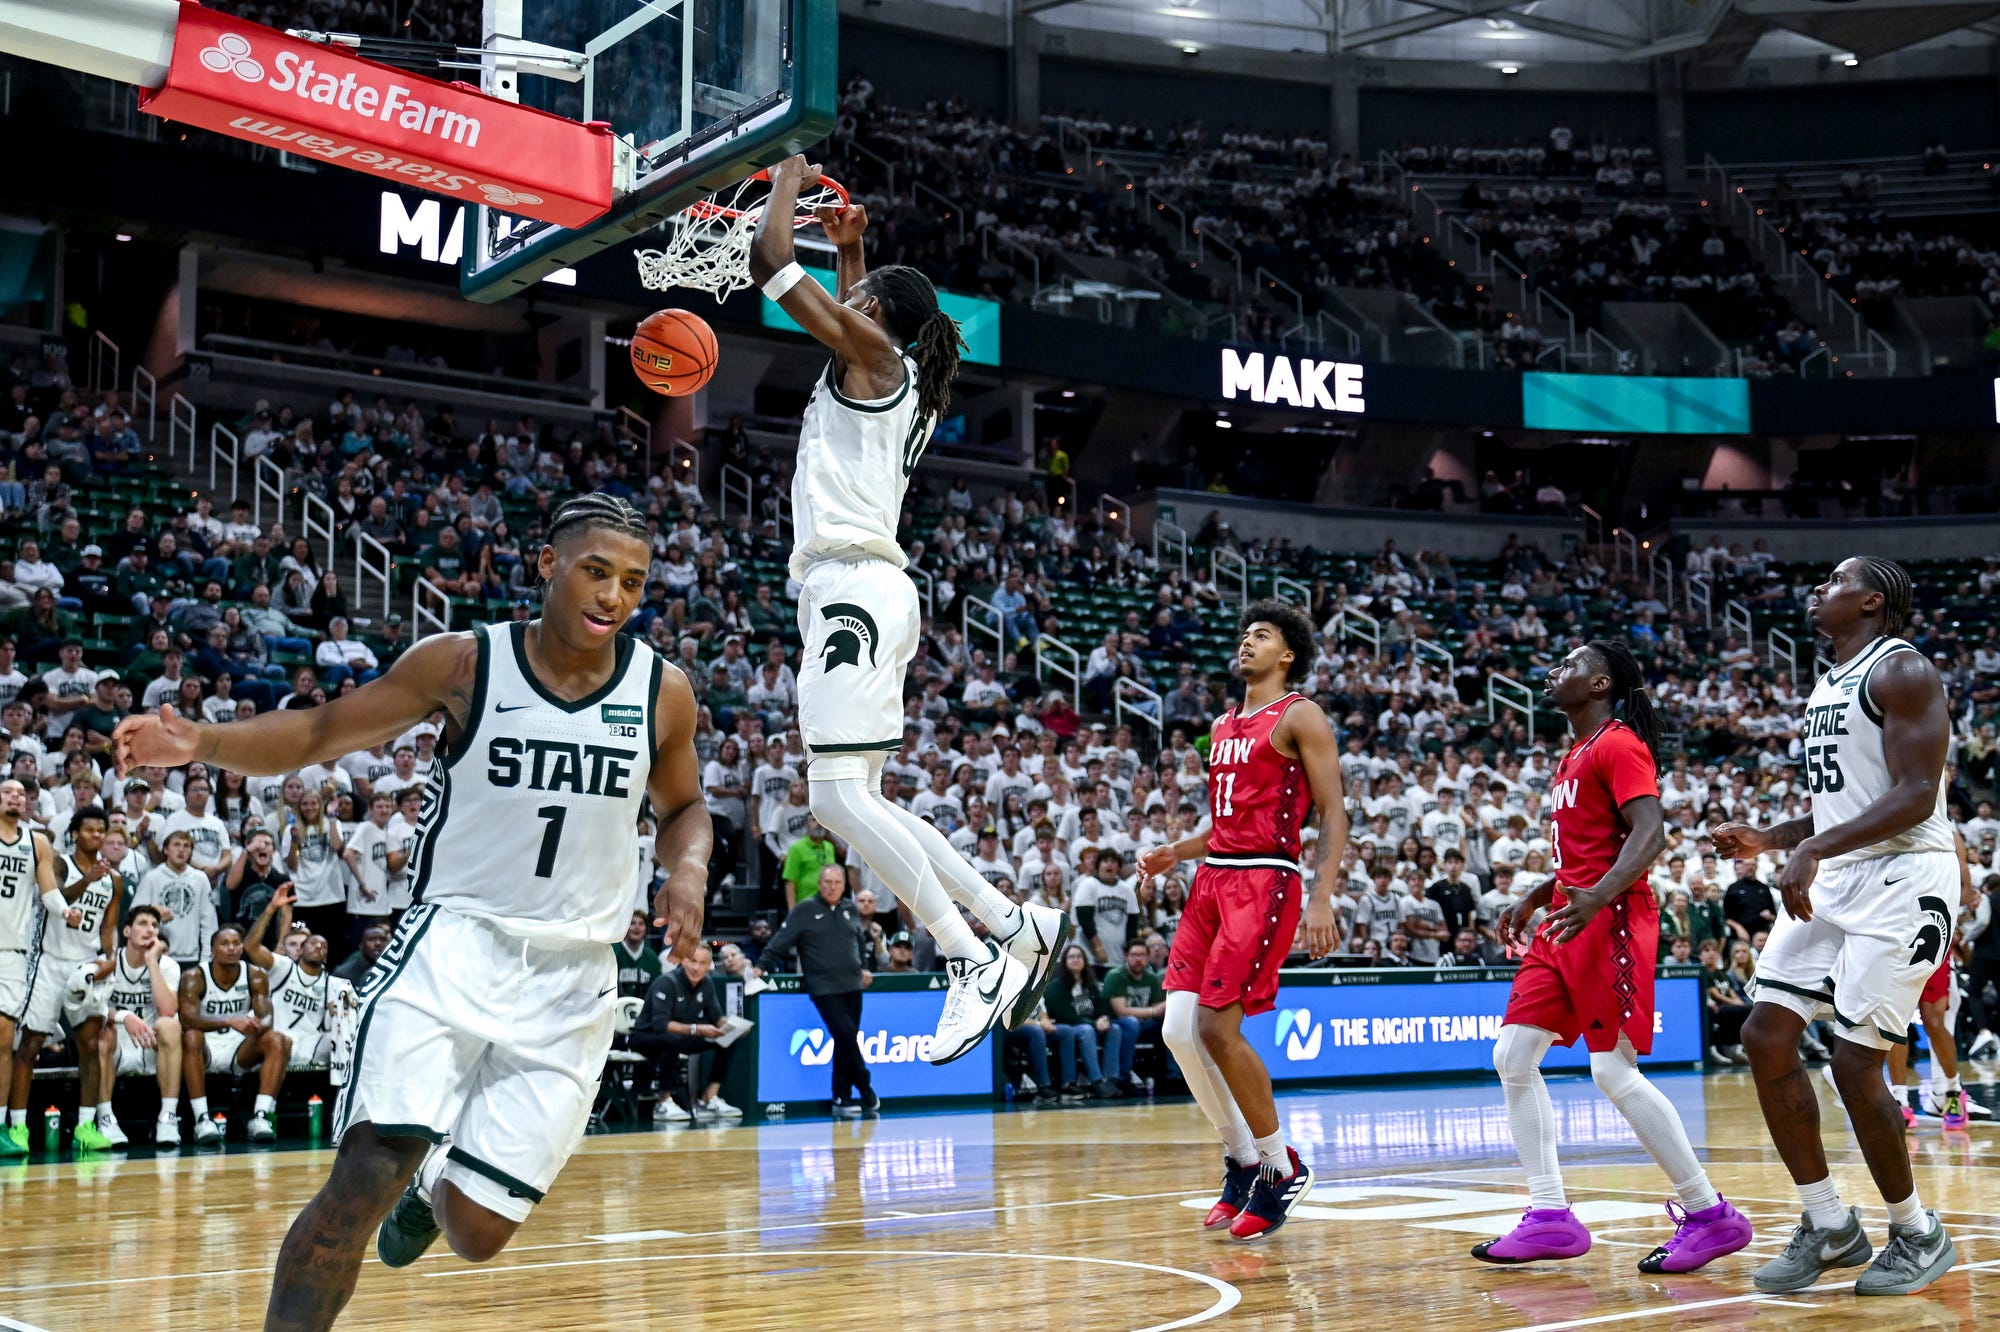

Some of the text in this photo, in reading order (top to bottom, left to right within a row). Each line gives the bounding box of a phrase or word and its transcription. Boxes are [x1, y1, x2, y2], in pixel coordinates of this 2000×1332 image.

[634, 347, 672, 371] ELITE
[1222, 348, 1366, 413] MAKE
[608, 708, 642, 719] msufcu
[1804, 702, 1850, 740] STATE
[488, 736, 638, 799] STATE
[1808, 743, 1845, 794] 55
[1215, 772, 1236, 818] 11
[534, 805, 568, 878] 1
[111, 989, 152, 1005] STATE
[206, 999, 247, 1015] STATE
[283, 989, 320, 1012] STATE
[288, 1009, 305, 1029] 7
[1330, 1018, 1369, 1047] THE
[1372, 1017, 1426, 1045] RIGHT
[1429, 1016, 1477, 1042] TEAM
